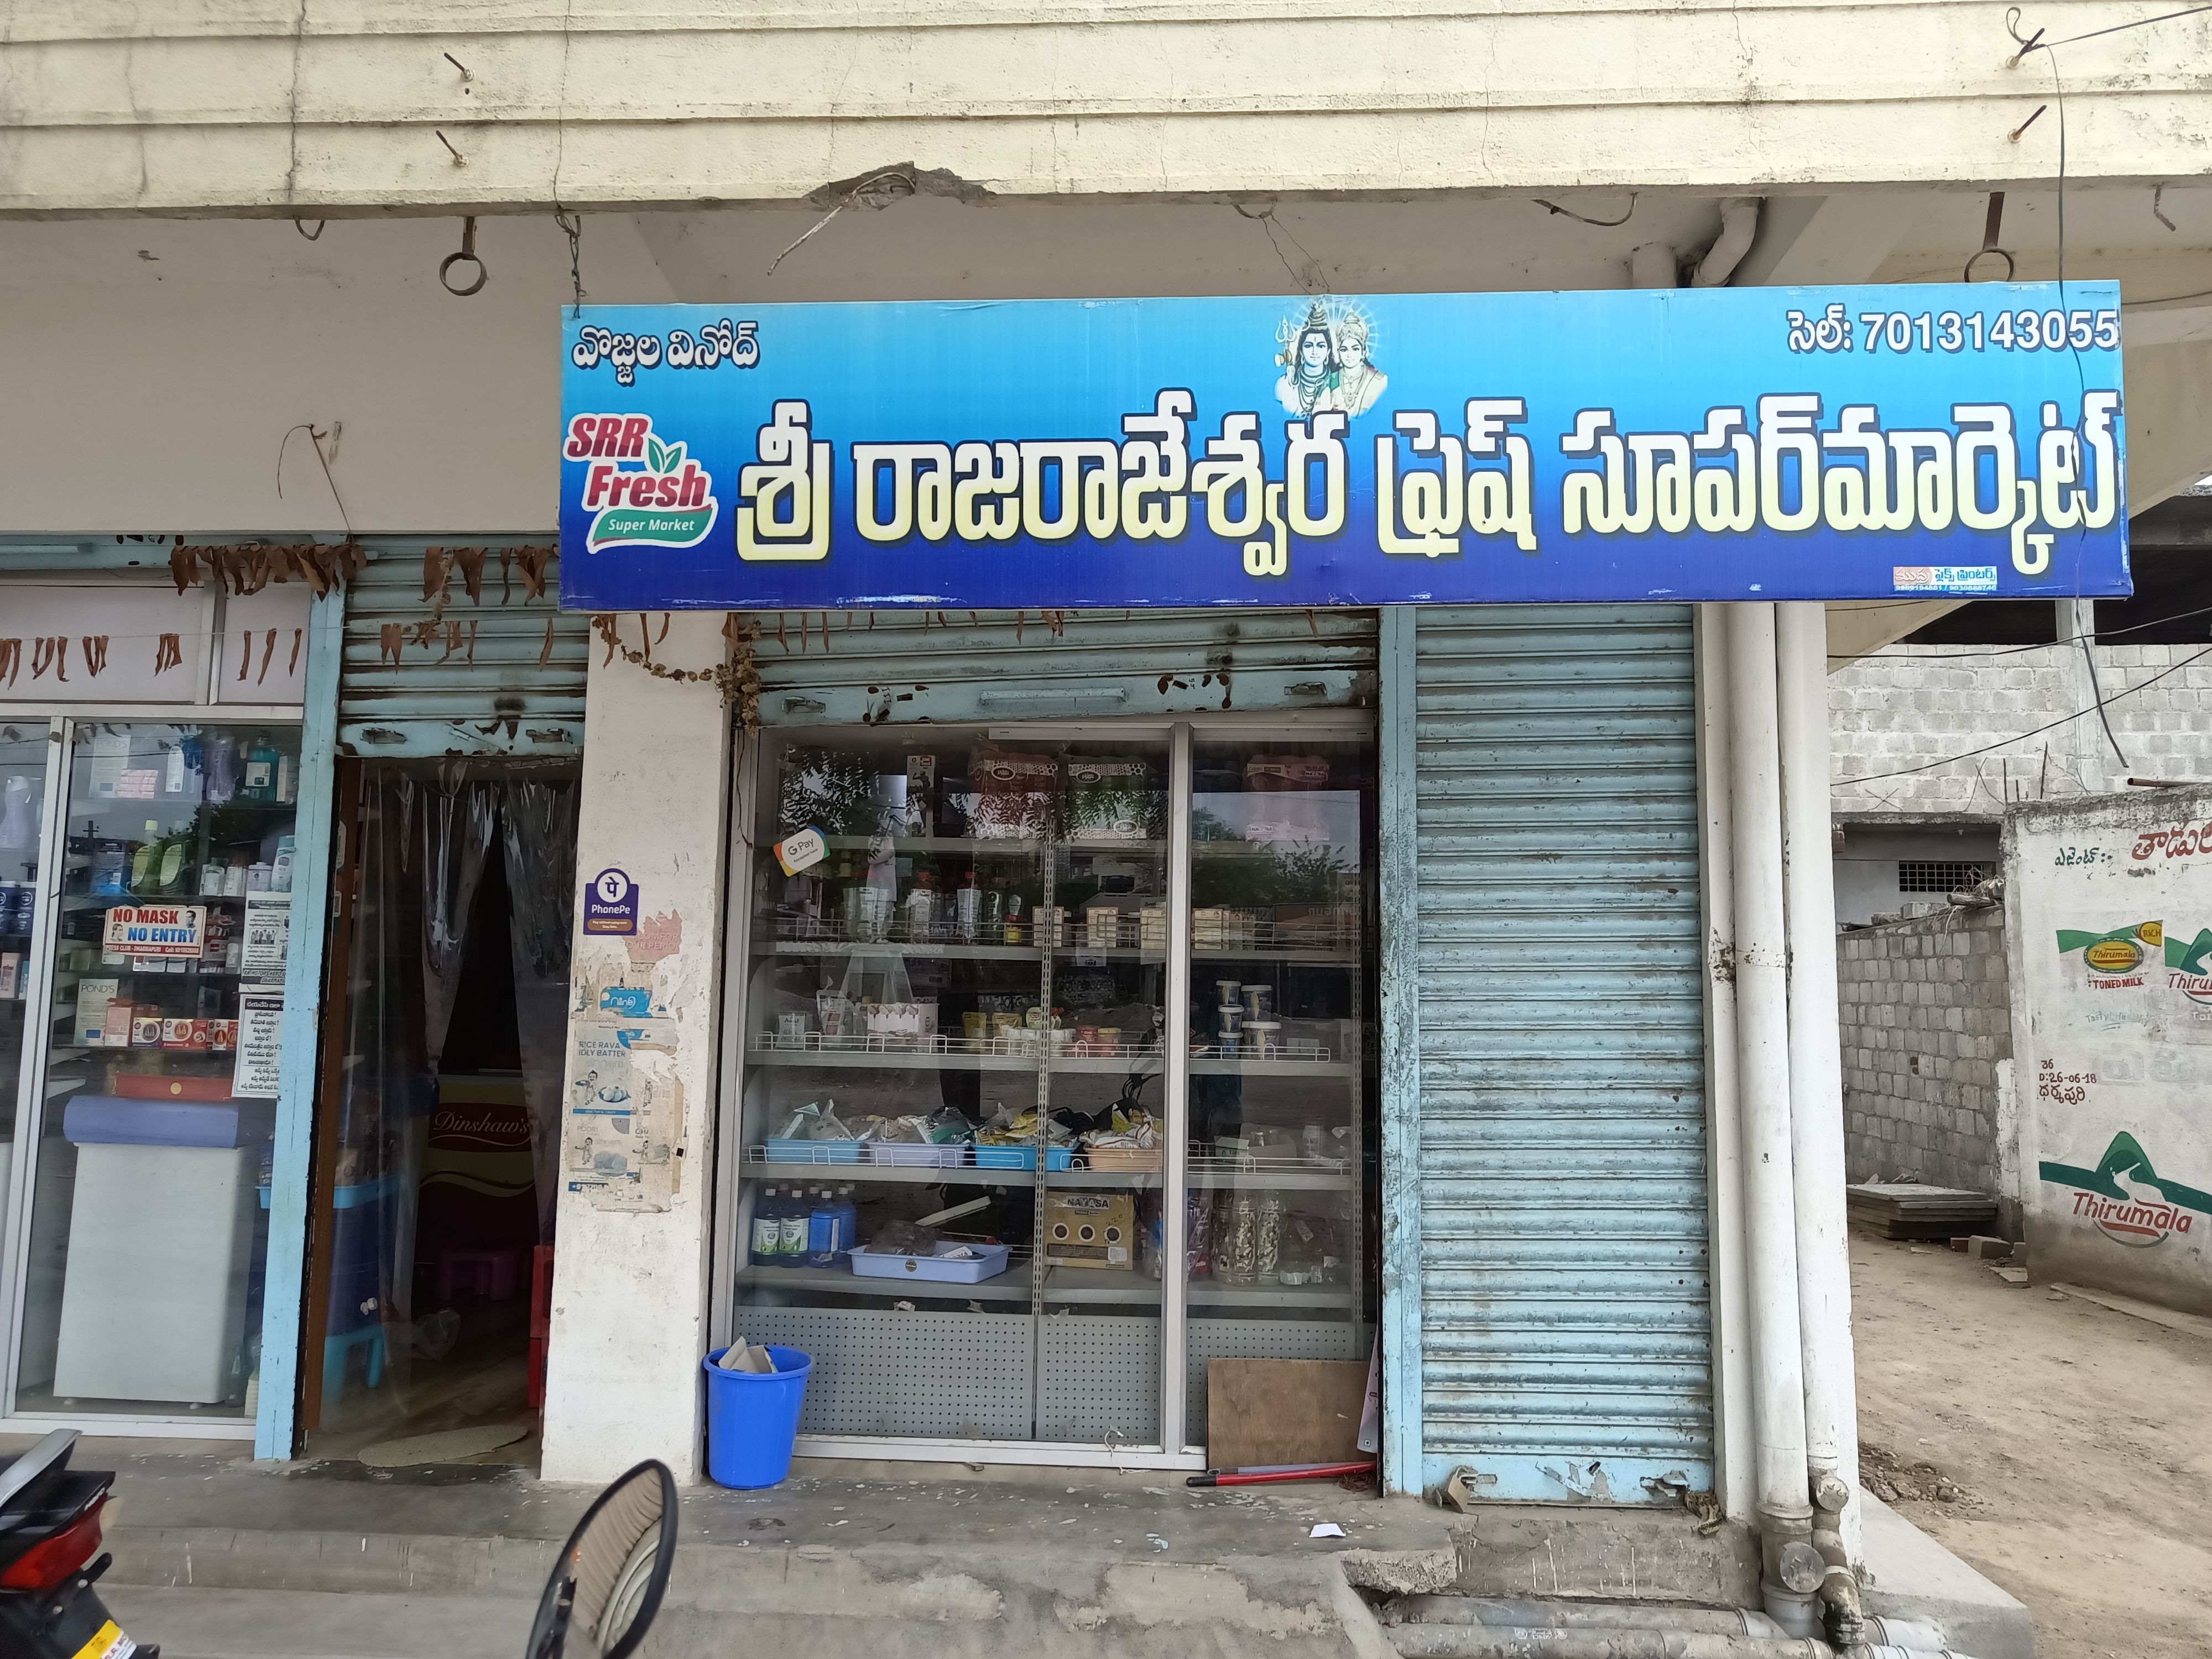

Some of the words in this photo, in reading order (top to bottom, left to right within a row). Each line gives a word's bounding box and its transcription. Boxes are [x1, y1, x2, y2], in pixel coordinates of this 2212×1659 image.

[1860, 310, 2120, 351] 7013143055
[667, 319, 759, 368] వినోద్
[568, 417, 649, 457] SRR
[587, 463, 707, 507] Fresh
[735, 399, 831, 561] శ్రీ
[852, 389, 1348, 576] రాజరాజేశ్వర
[608, 518, 645, 533] Super
[649, 518, 695, 532] Market
[797, 838, 814, 851] Pay
[113, 909, 133, 922] NO
[136, 909, 179, 924] MASK
[591, 904, 630, 914] PhonePe
[128, 927, 148, 941] NO
[151, 928, 197, 943] ENTRY
[2143, 929, 2162, 938] RICH
[2093, 949, 2136, 959] Thirumala
[2093, 979, 2121, 989] TONED
[2122, 977, 2144, 988] MILK
[433, 1111, 530, 1134] Dinshaw's
[2072, 1192, 2193, 1234] Thirumala
